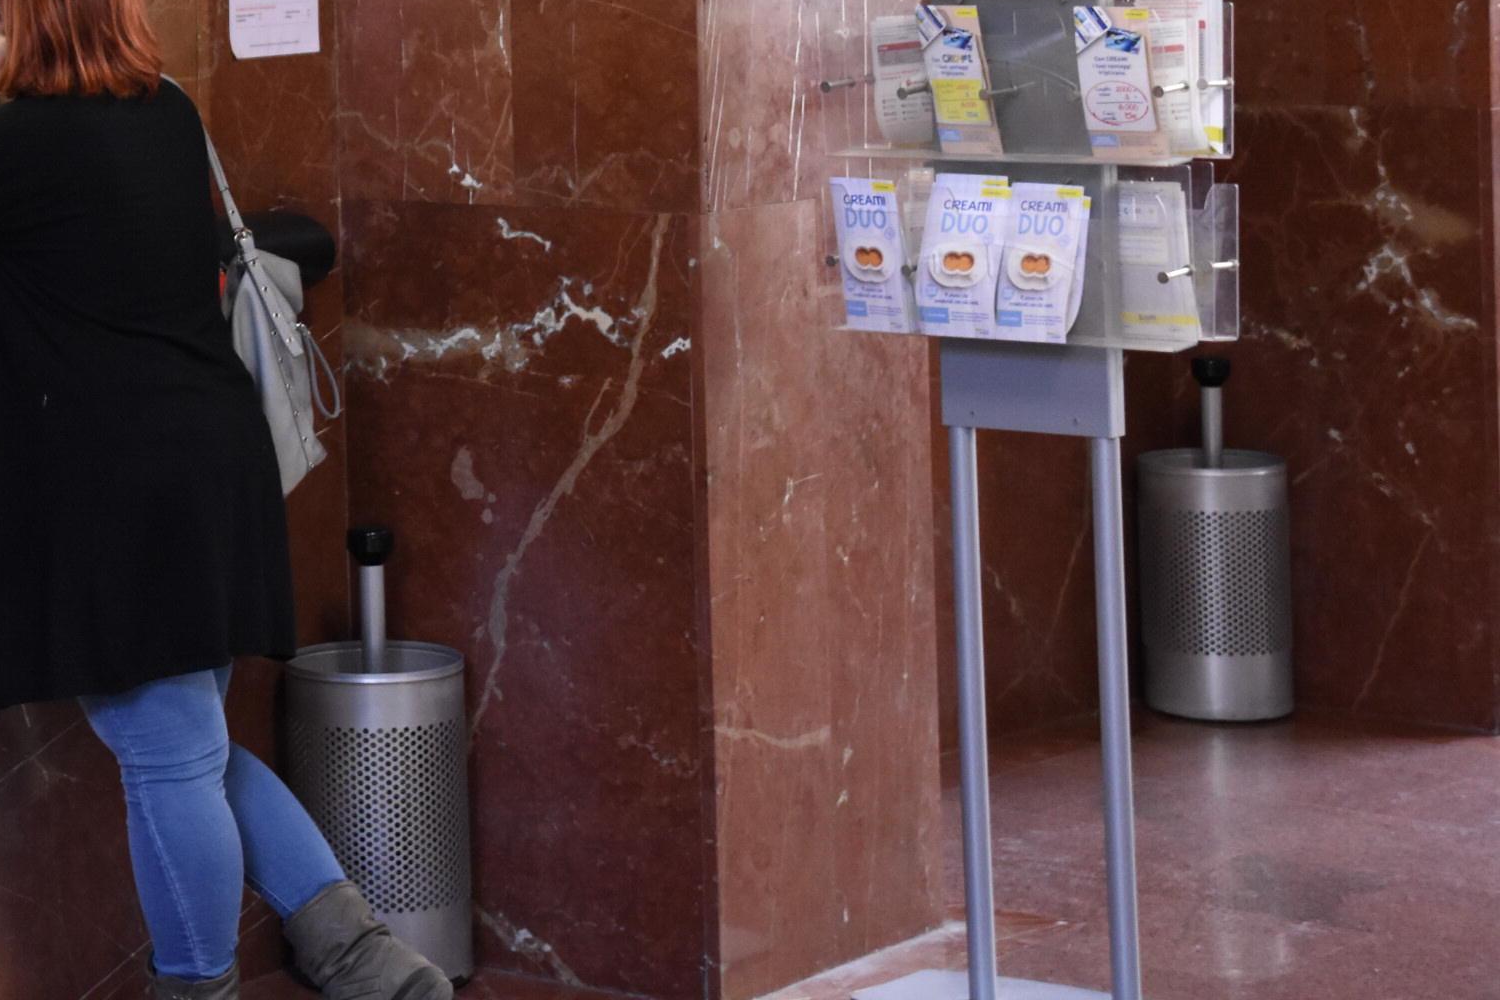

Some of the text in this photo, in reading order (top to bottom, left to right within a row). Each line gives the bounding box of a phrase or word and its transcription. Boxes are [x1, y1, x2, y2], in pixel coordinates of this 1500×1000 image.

[843, 193, 886, 206] CREAMI
[943, 199, 993, 212] CREAMI
[1020, 200, 1068, 212] CREAMI
[845, 207, 887, 229] DUO
[940, 212, 989, 234] DUO
[1017, 214, 1064, 236] DUO
